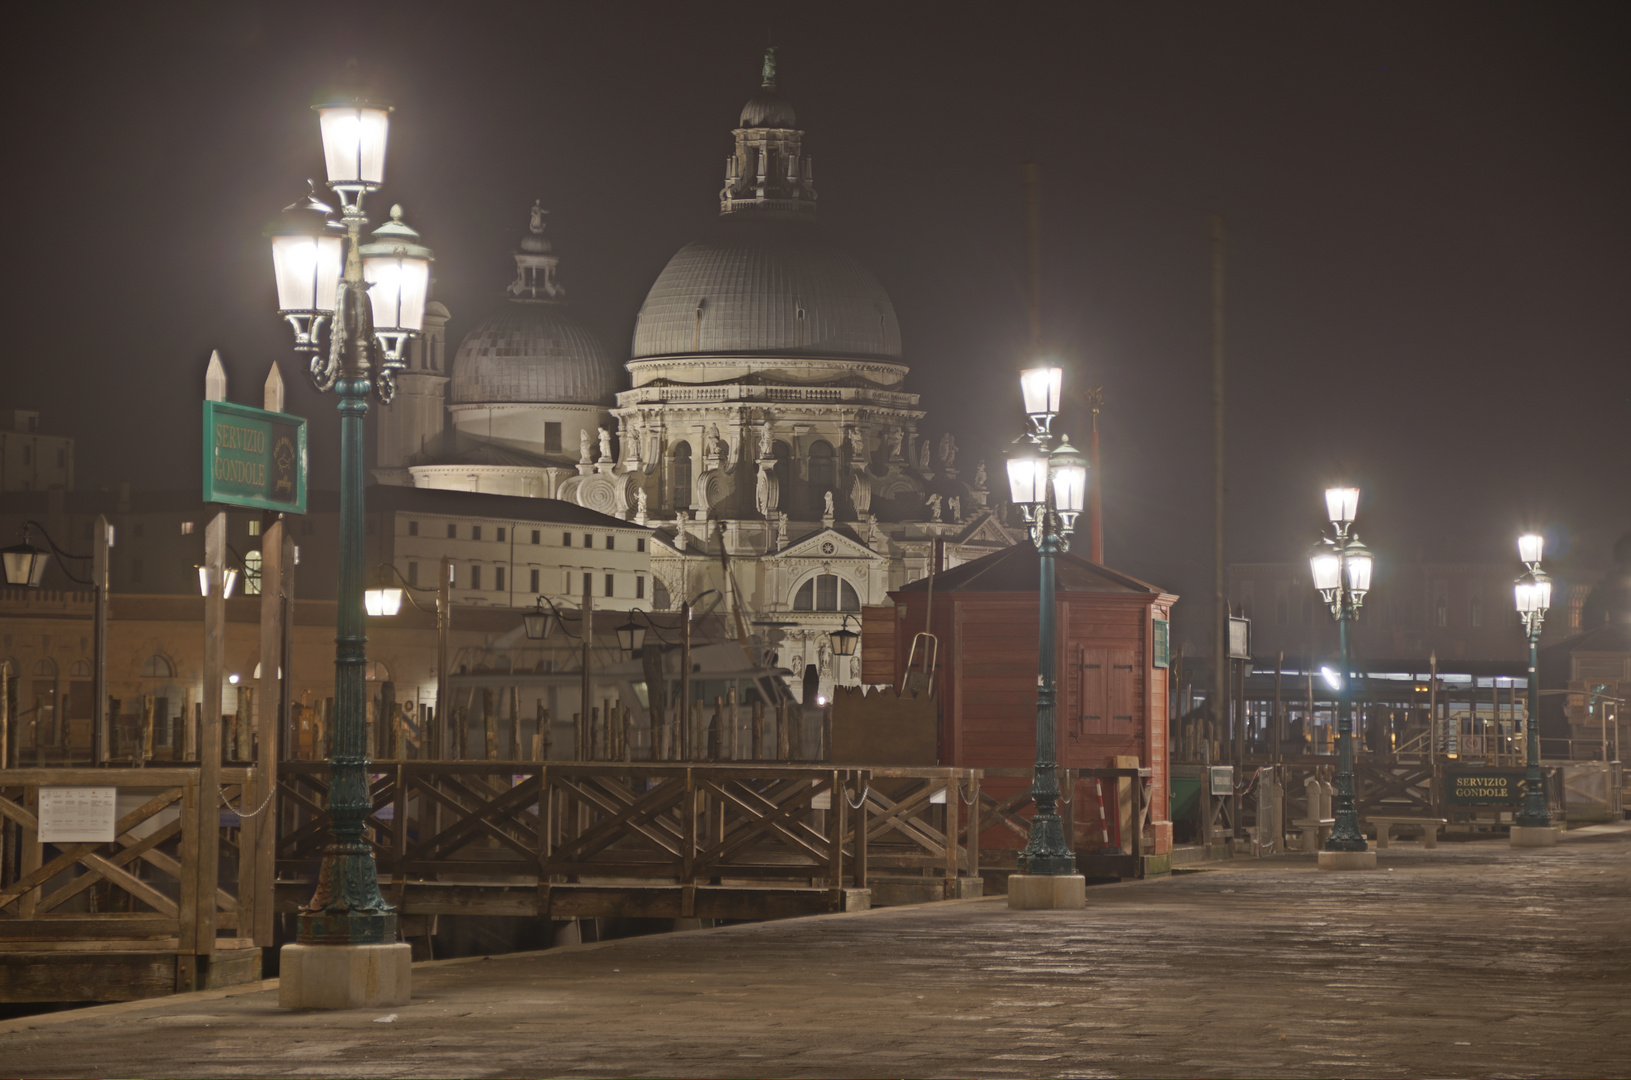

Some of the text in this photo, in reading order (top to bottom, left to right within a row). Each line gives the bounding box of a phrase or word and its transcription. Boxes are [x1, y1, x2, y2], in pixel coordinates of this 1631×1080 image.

[216, 423, 265, 454] SERVIZIO
[215, 456, 265, 486] GONDOLE
[1456, 777, 1507, 787] SERVIZIO
[1456, 788, 1508, 797] GONDOLE
